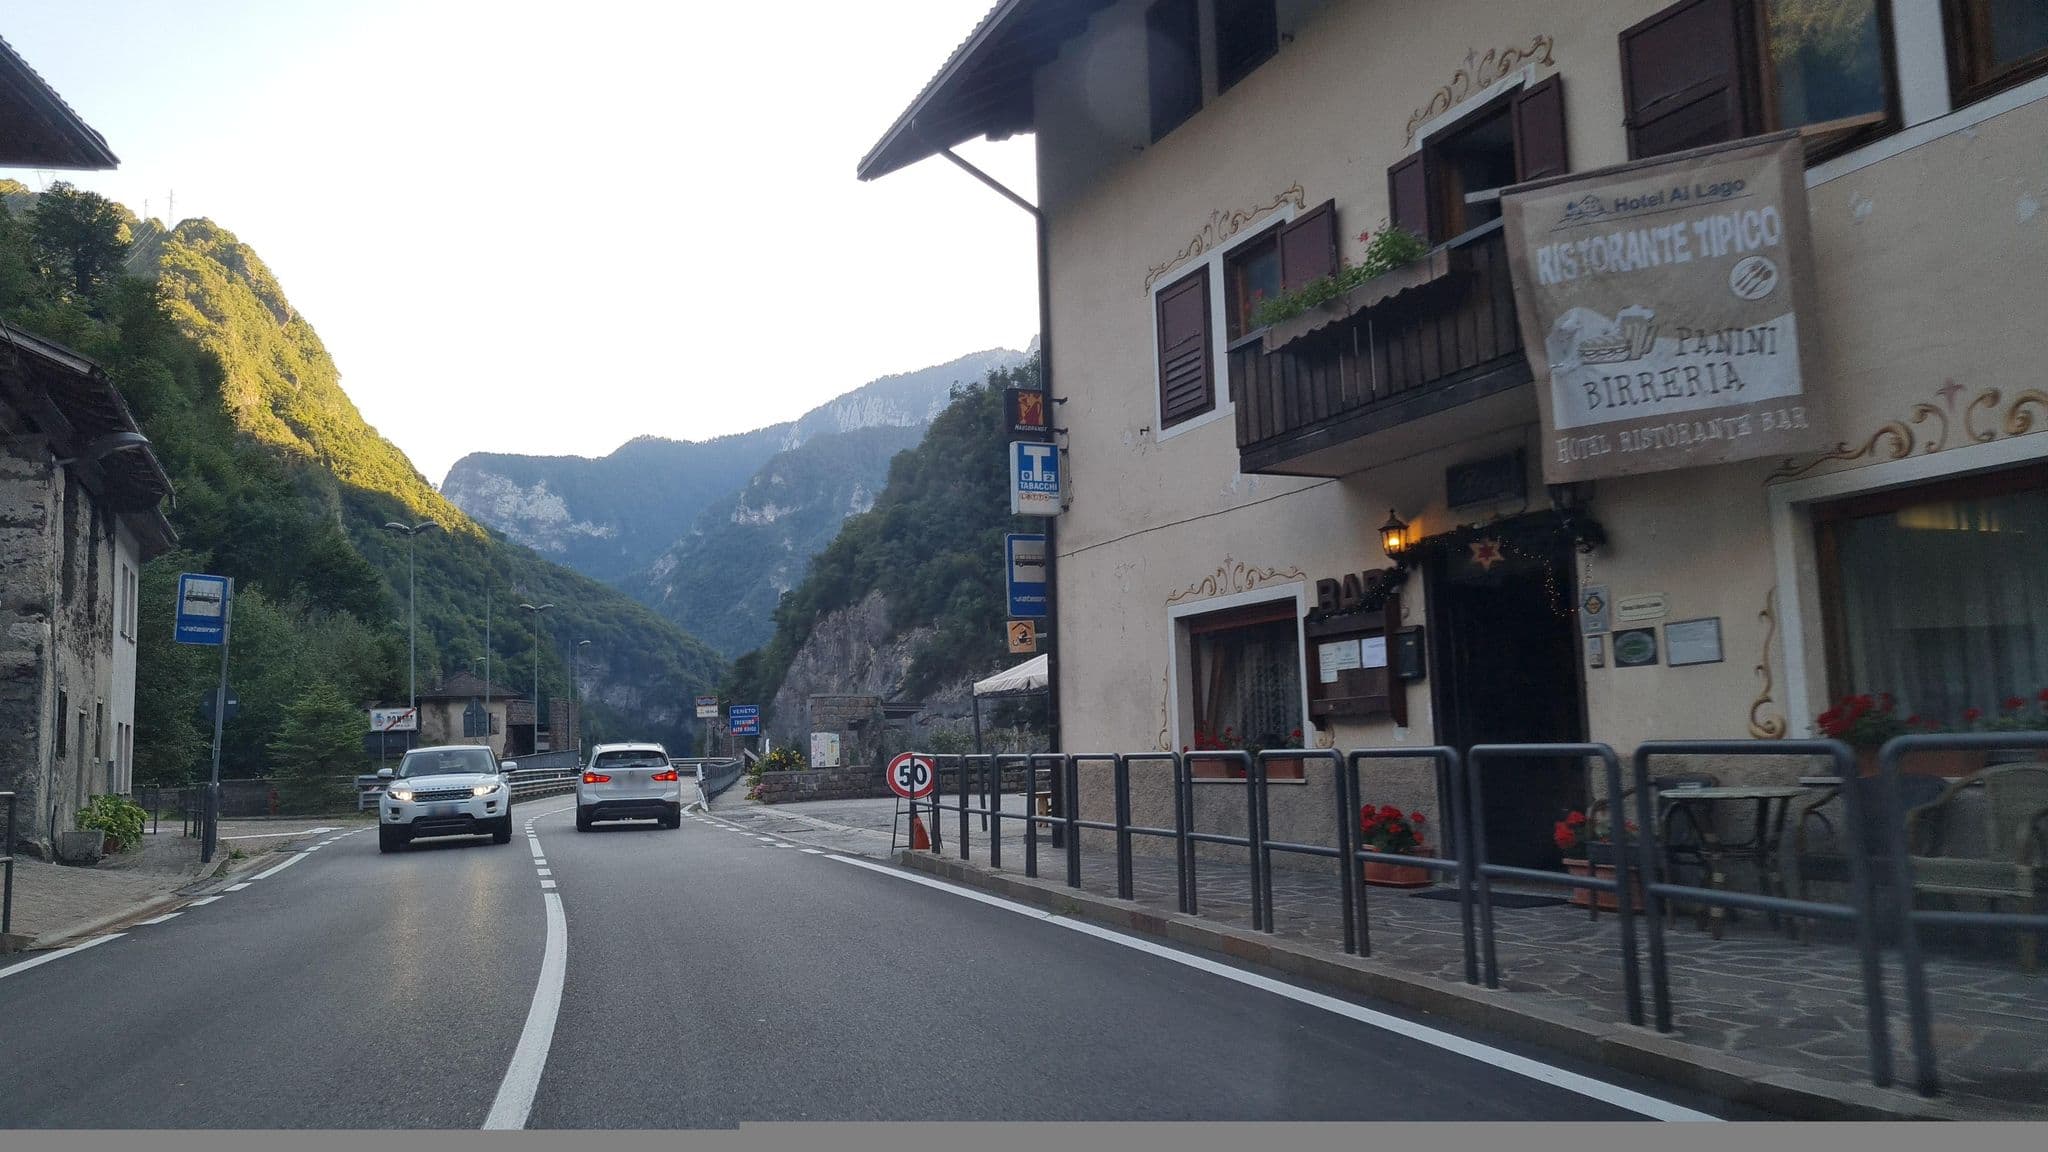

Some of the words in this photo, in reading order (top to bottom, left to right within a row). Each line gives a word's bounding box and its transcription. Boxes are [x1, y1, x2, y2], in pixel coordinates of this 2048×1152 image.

[1614, 189, 1665, 213] Hotel
[1695, 178, 1746, 199] Lago
[1536, 220, 1693, 286] RISTORANTE
[1694, 207, 1781, 257] TIPICO
[1675, 326, 1778, 357] PANINI
[1583, 361, 1745, 411] BIRRERIA
[1555, 434, 1612, 463] HOTEL
[1619, 413, 1754, 453] RISTORANTE
[1760, 406, 1809, 432] BAR
[1019, 481, 1058, 491] TABACCHI
[899, 764, 928, 786] 50
